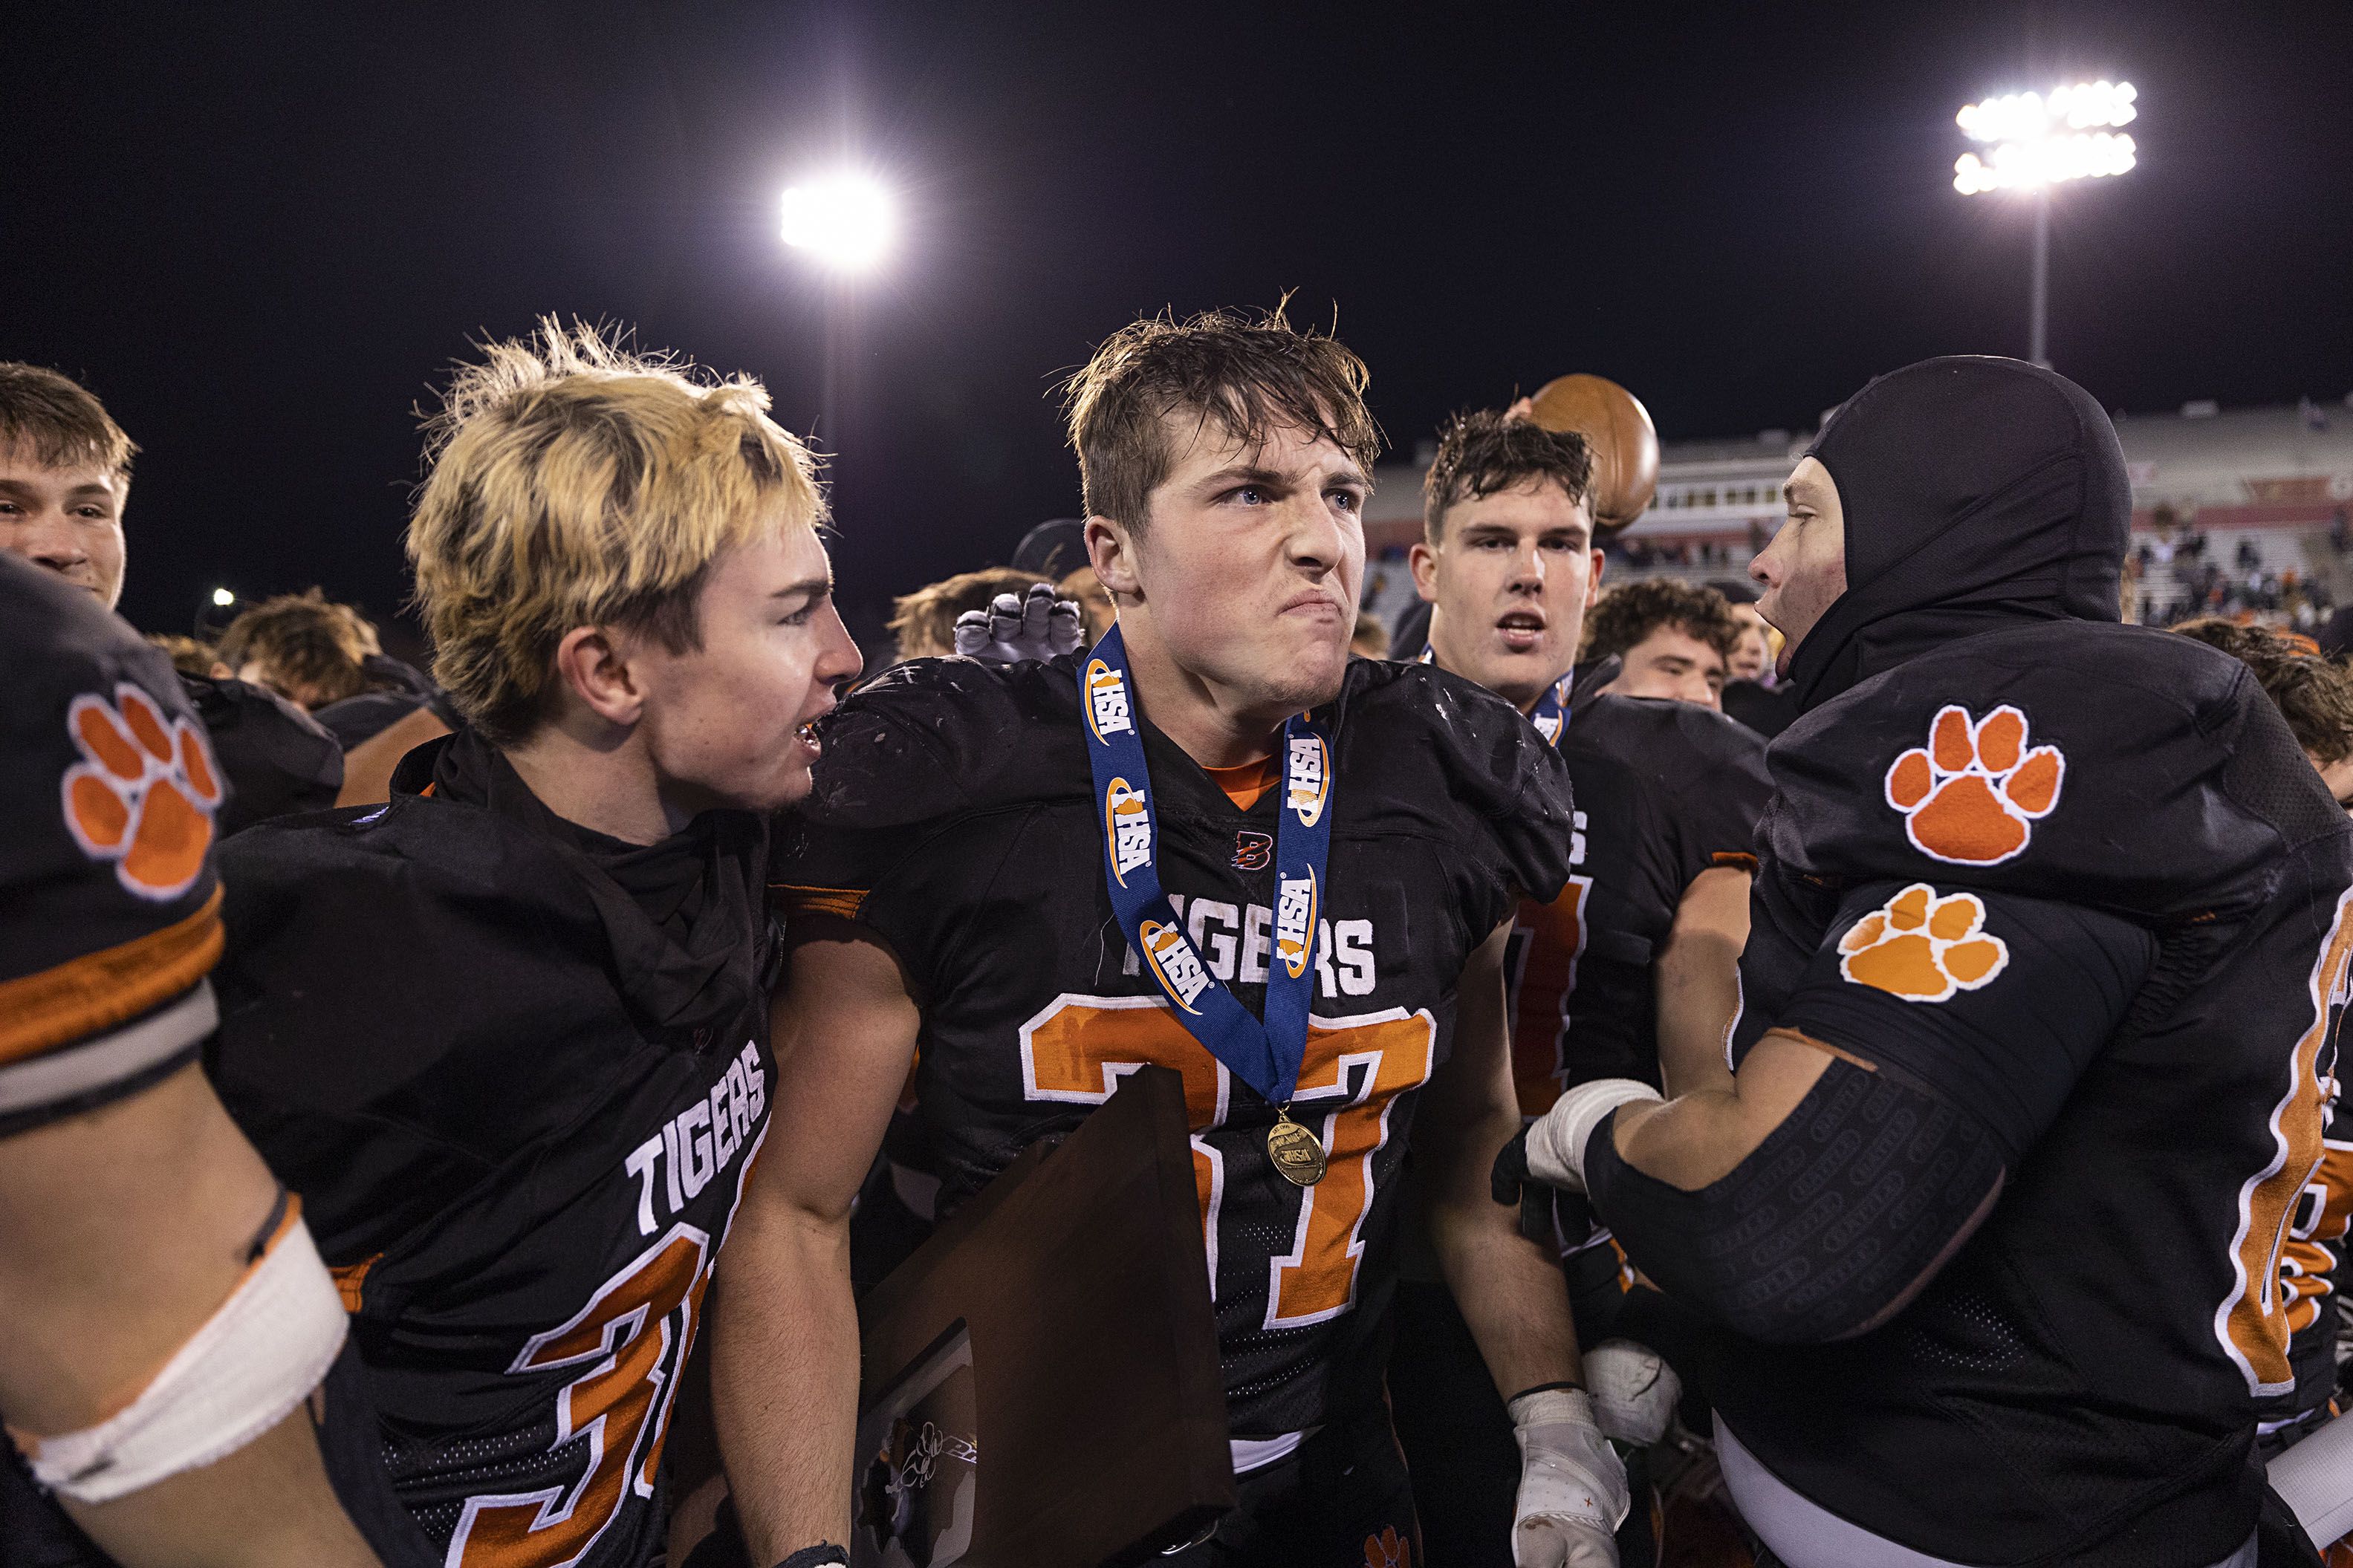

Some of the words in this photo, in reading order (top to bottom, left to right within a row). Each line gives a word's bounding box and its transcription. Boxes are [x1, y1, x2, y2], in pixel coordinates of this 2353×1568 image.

[1089, 669, 1131, 735] IHSA
[1287, 738, 1322, 816] IHSA
[1111, 788, 1152, 875] IHSA
[1231, 830, 1273, 870] B
[1144, 921, 1210, 1006] IHSA
[1276, 879, 1312, 964] IHSA
[626, 1040, 765, 1235] TIGERS
